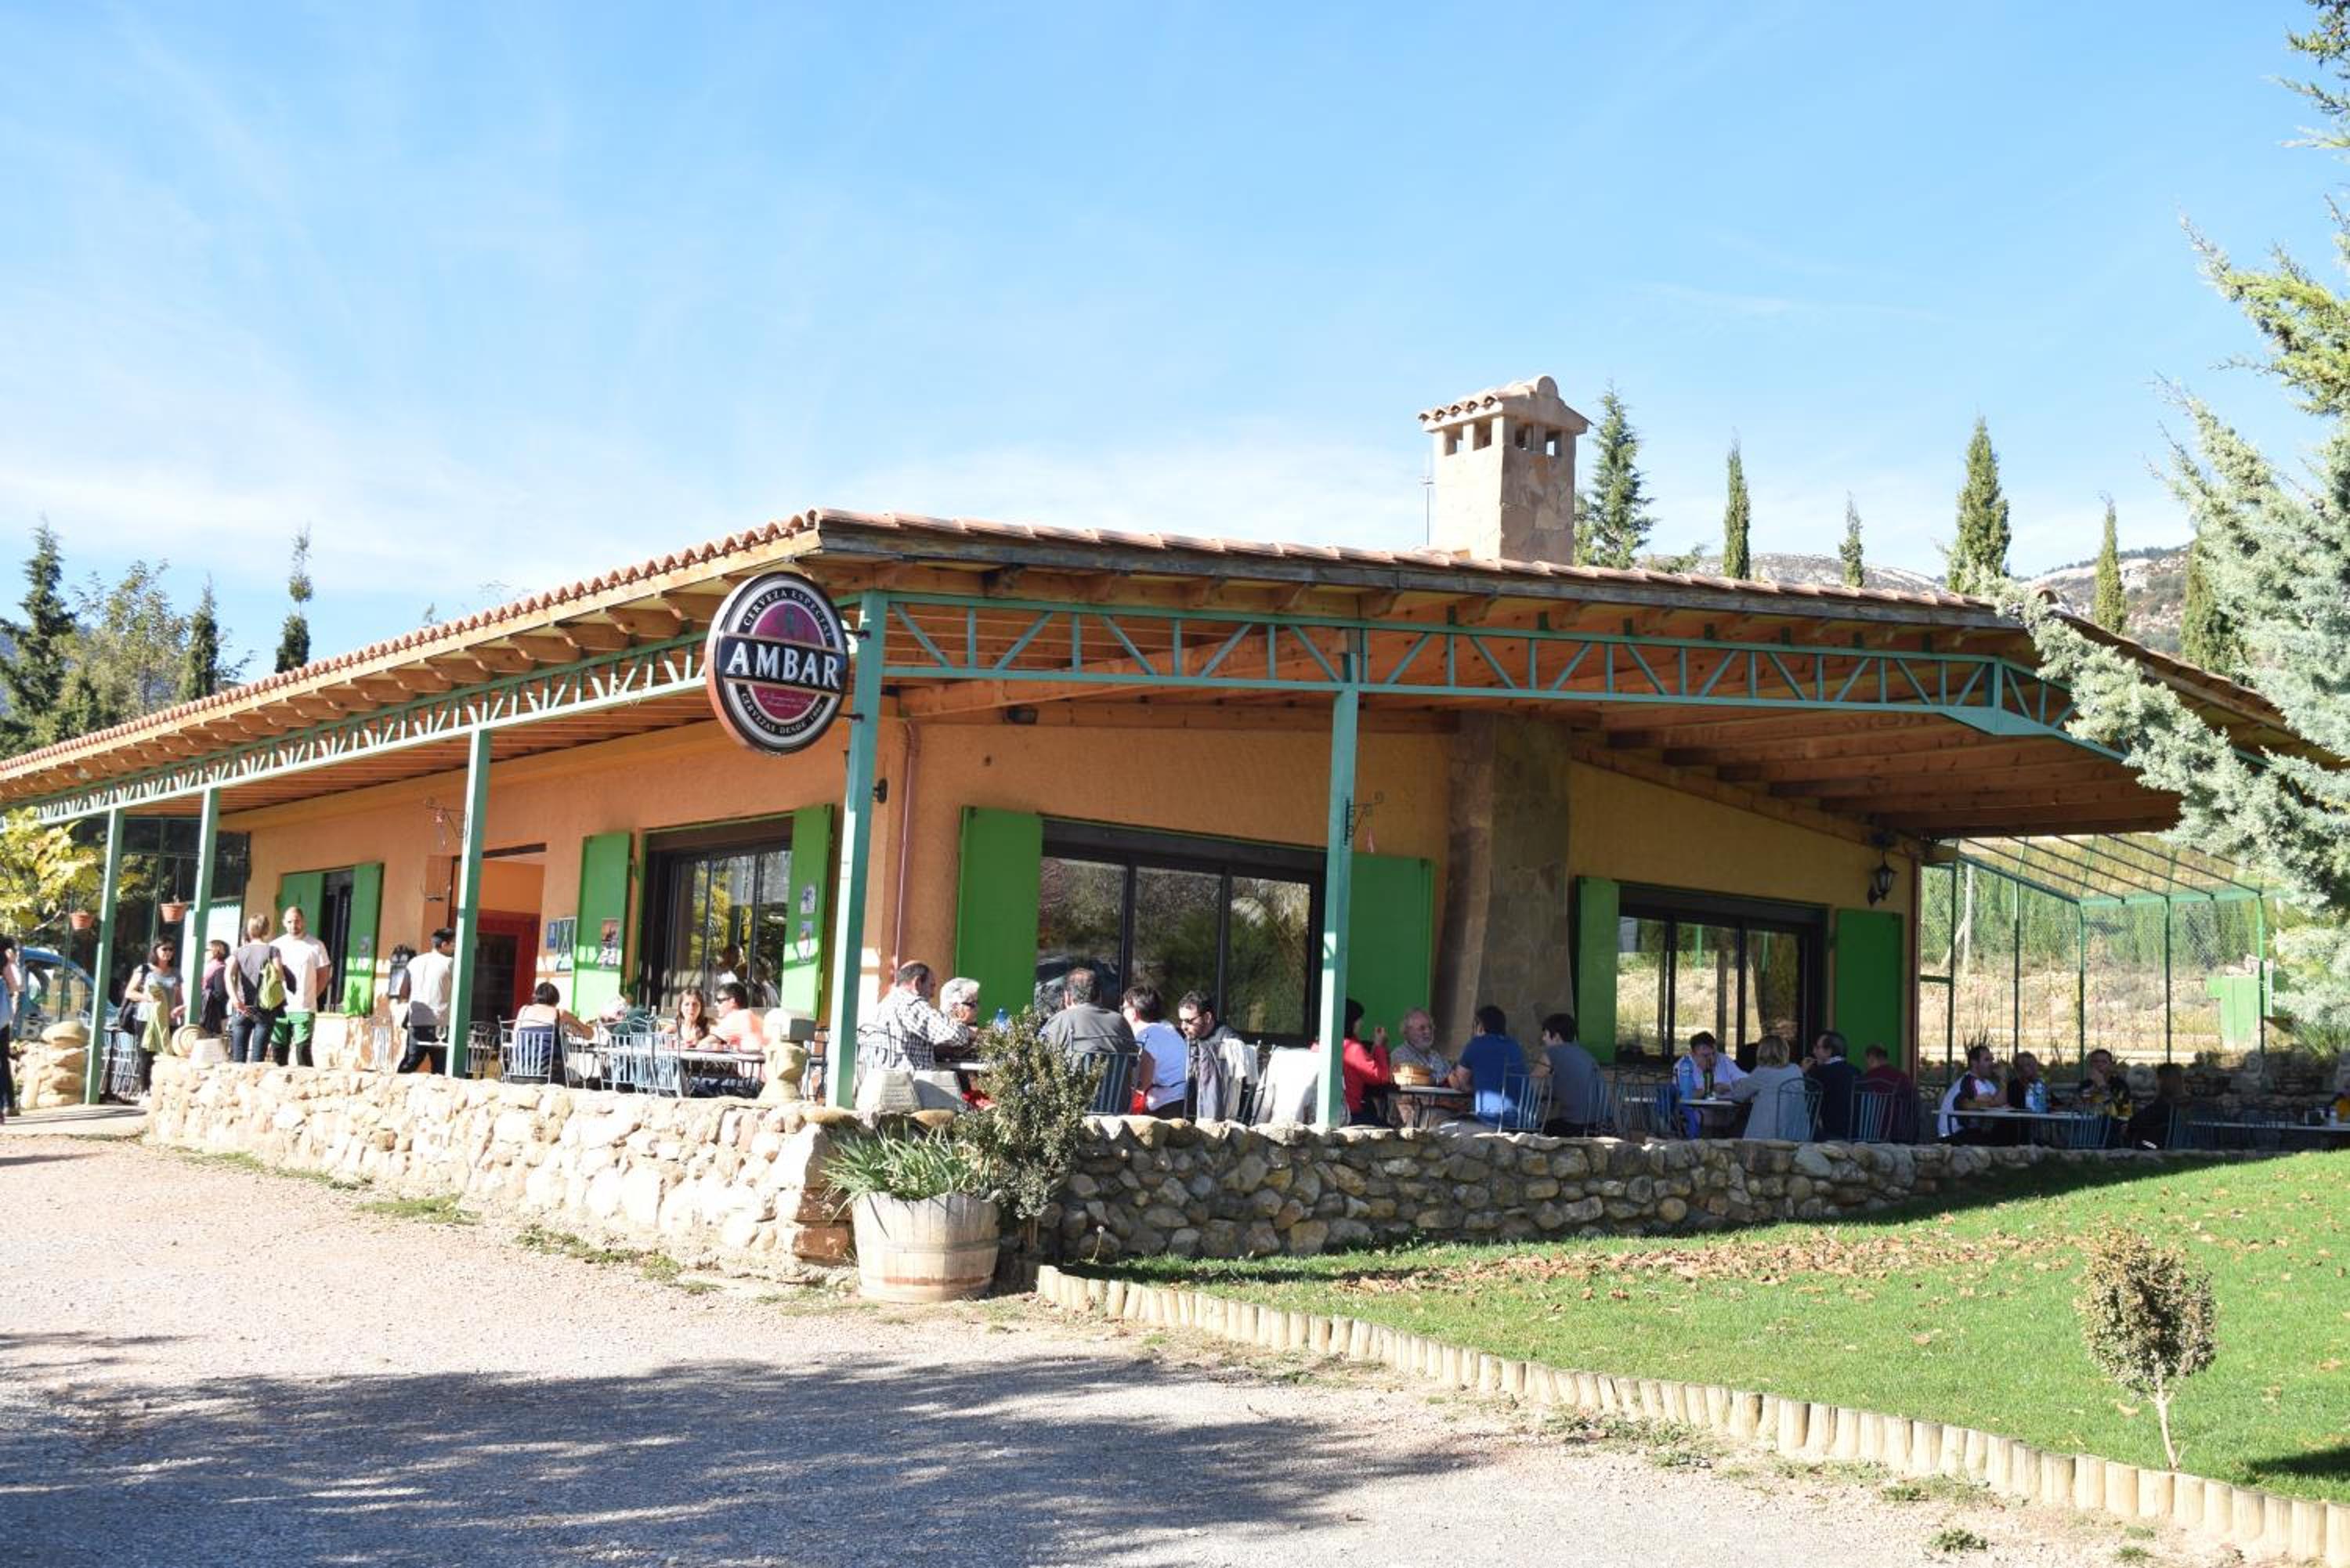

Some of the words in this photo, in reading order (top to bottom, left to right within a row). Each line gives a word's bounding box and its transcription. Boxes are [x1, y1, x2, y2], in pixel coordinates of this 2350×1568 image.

[743, 590, 788, 626] CERVEZA
[791, 591, 833, 641] ESPECIAL
[725, 641, 841, 690] AMBAR
[741, 693, 776, 732] CERVEZAS
[779, 721, 808, 734] DESDE
